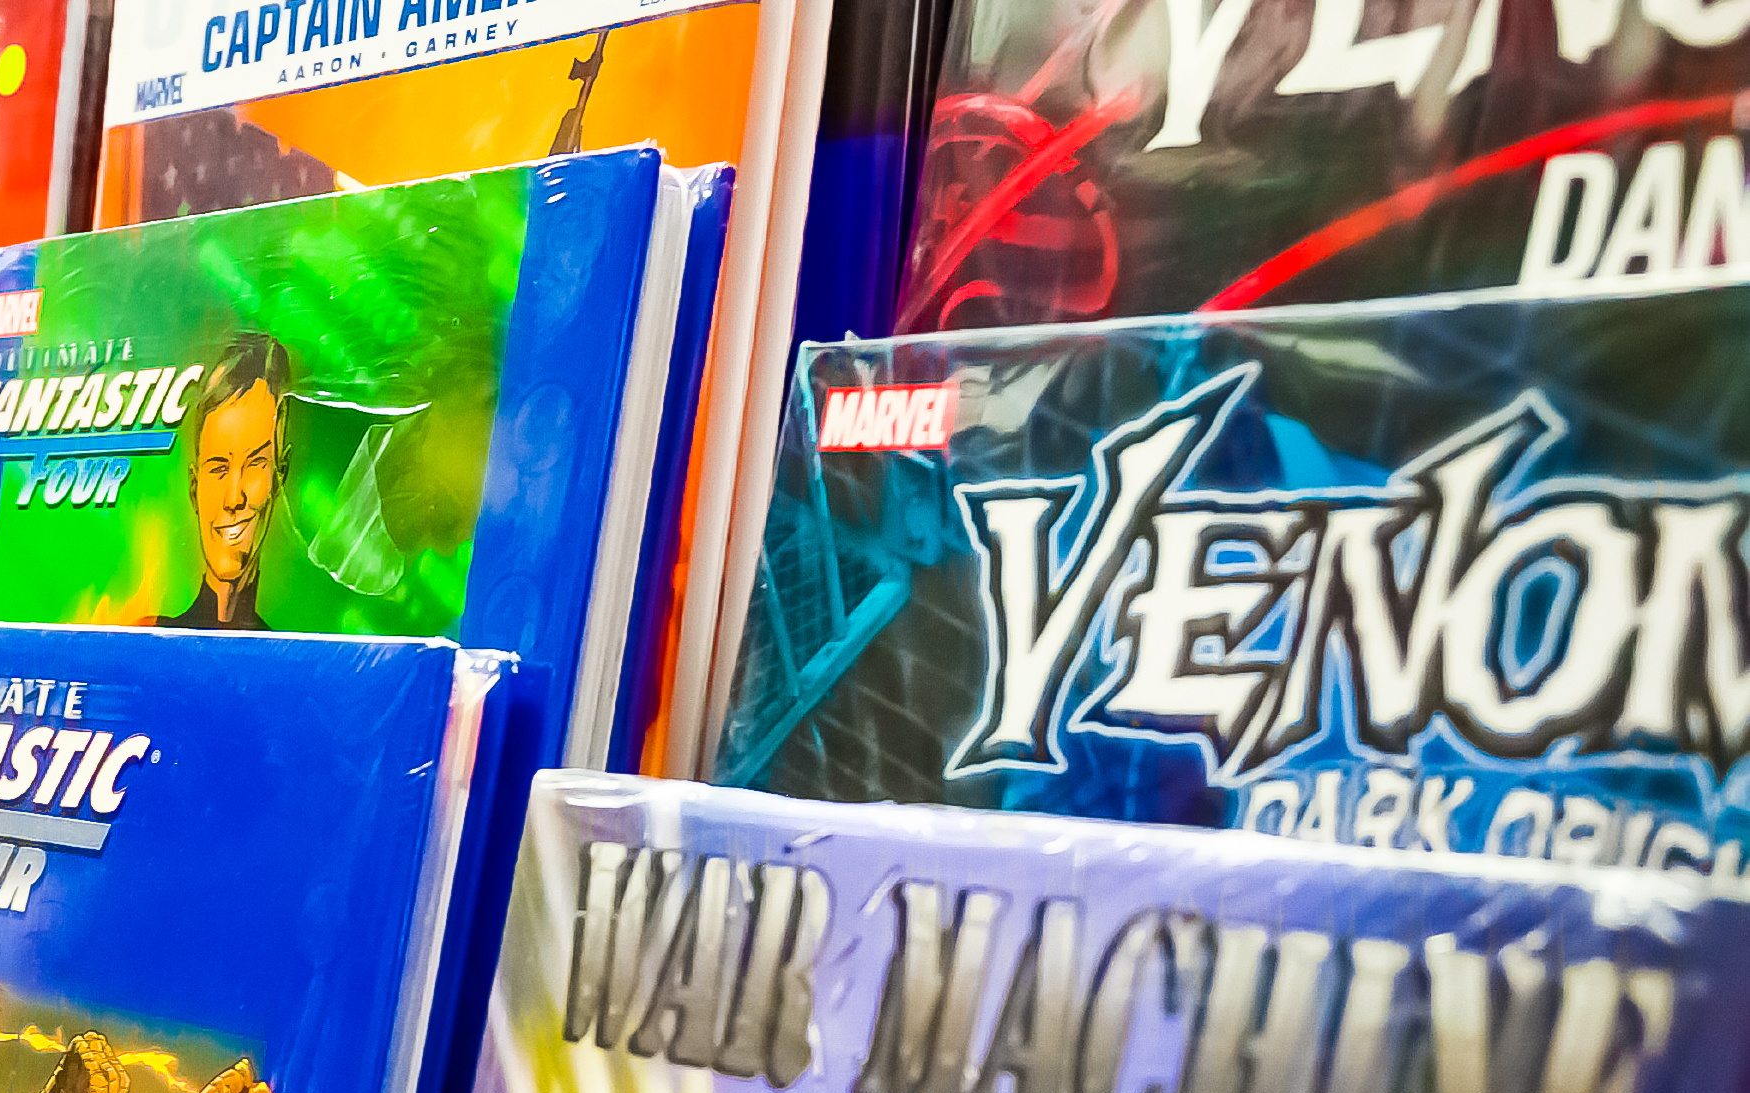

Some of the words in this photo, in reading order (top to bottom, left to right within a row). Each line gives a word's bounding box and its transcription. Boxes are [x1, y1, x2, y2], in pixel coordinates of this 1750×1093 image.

[202, 0, 383, 73] CAPTAIN
[278, 53, 363, 84] AARON
[406, 19, 519, 58] GARNEY
[135, 71, 185, 111] MARVEL
[820, 388, 949, 448] MARVEL
[15, 455, 132, 509] FOUR
[562, 840, 838, 1092] WAR
